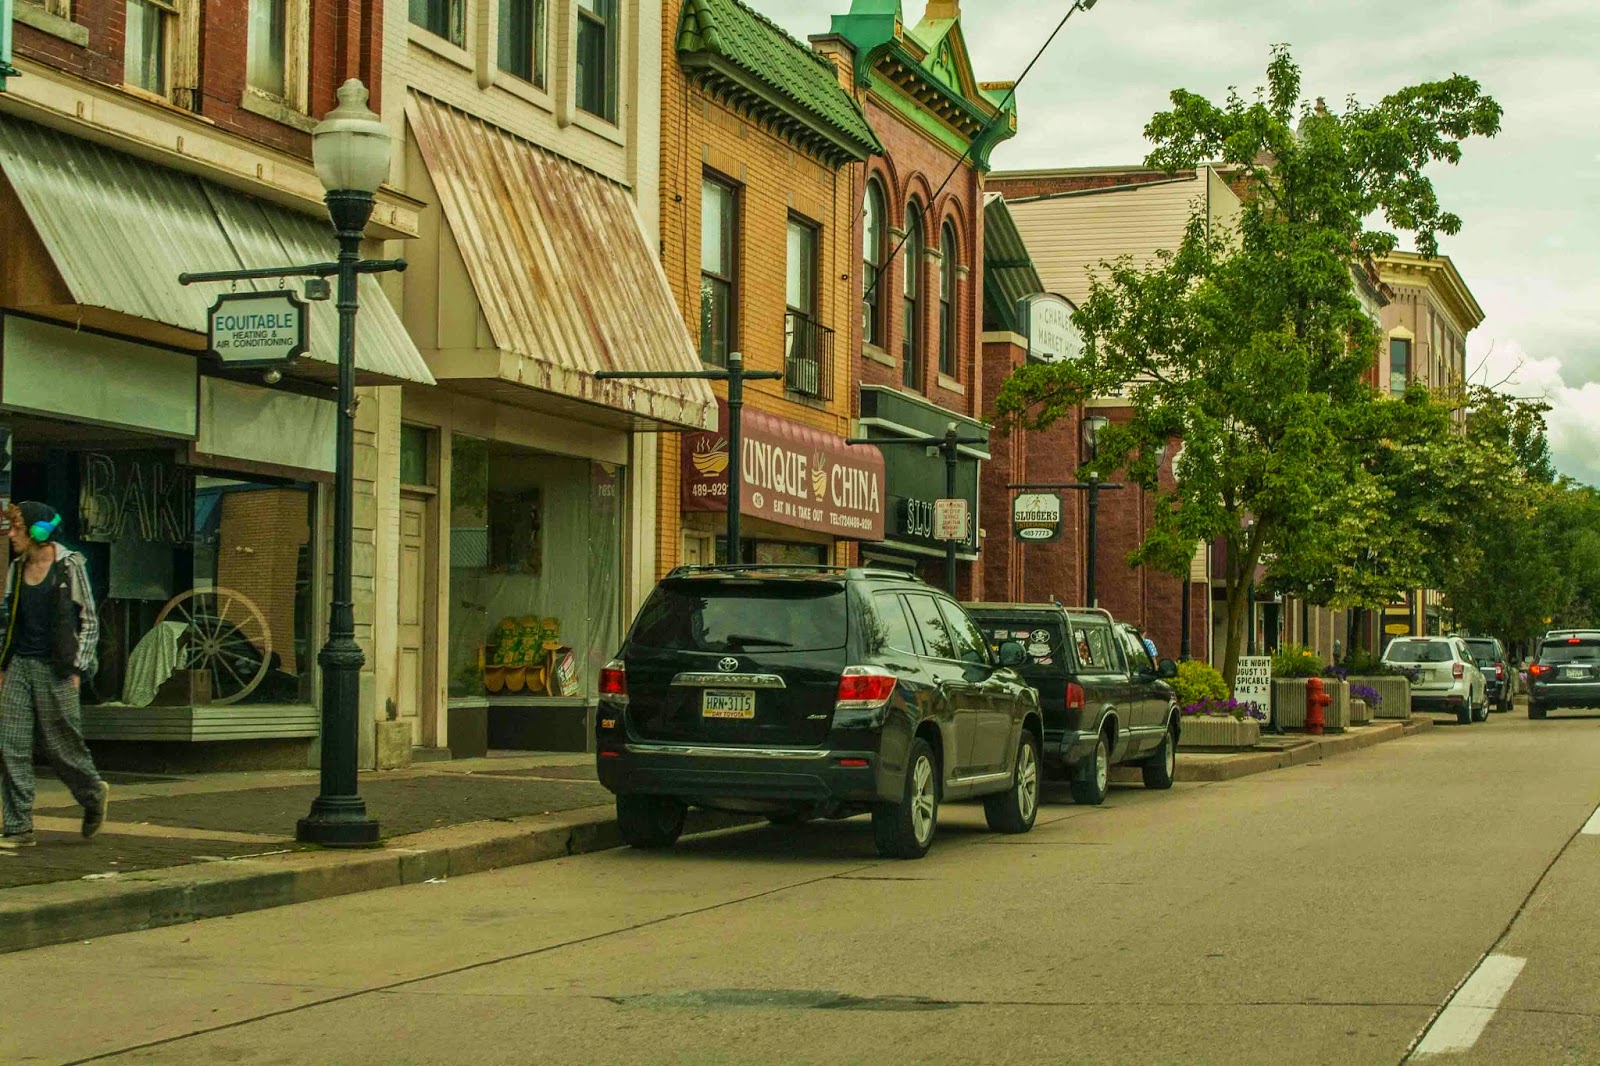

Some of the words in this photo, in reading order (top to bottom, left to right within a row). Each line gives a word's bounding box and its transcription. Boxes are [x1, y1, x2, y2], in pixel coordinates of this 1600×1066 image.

[216, 313, 293, 331] EQUITABLE
[232, 331, 268, 339] HEATING
[271, 330, 277, 338] &
[216, 340, 230, 349] AIR
[233, 338, 294, 348] CONDITIONING
[1039, 328, 1063, 354] MARKET
[742, 437, 807, 499] UNIQUE
[831, 463, 880, 513] CHINA
[692, 482, 729, 496] 489-929
[773, 500, 784, 514] EAT
[785, 502, 791, 516] IN
[792, 504, 797, 517] &
[798, 505, 811, 520] TAKE
[812, 508, 824, 522] OUT
[1238, 659, 1249, 667] VIE
[1250, 659, 1270, 667] NIGHT
[1237, 668, 1257, 676] UGUST
[1260, 668, 1267, 676] 13
[1237, 677, 1269, 685] SPICABLE
[1240, 686, 1250, 694] ME
[1254, 686, 1259, 694] 2
